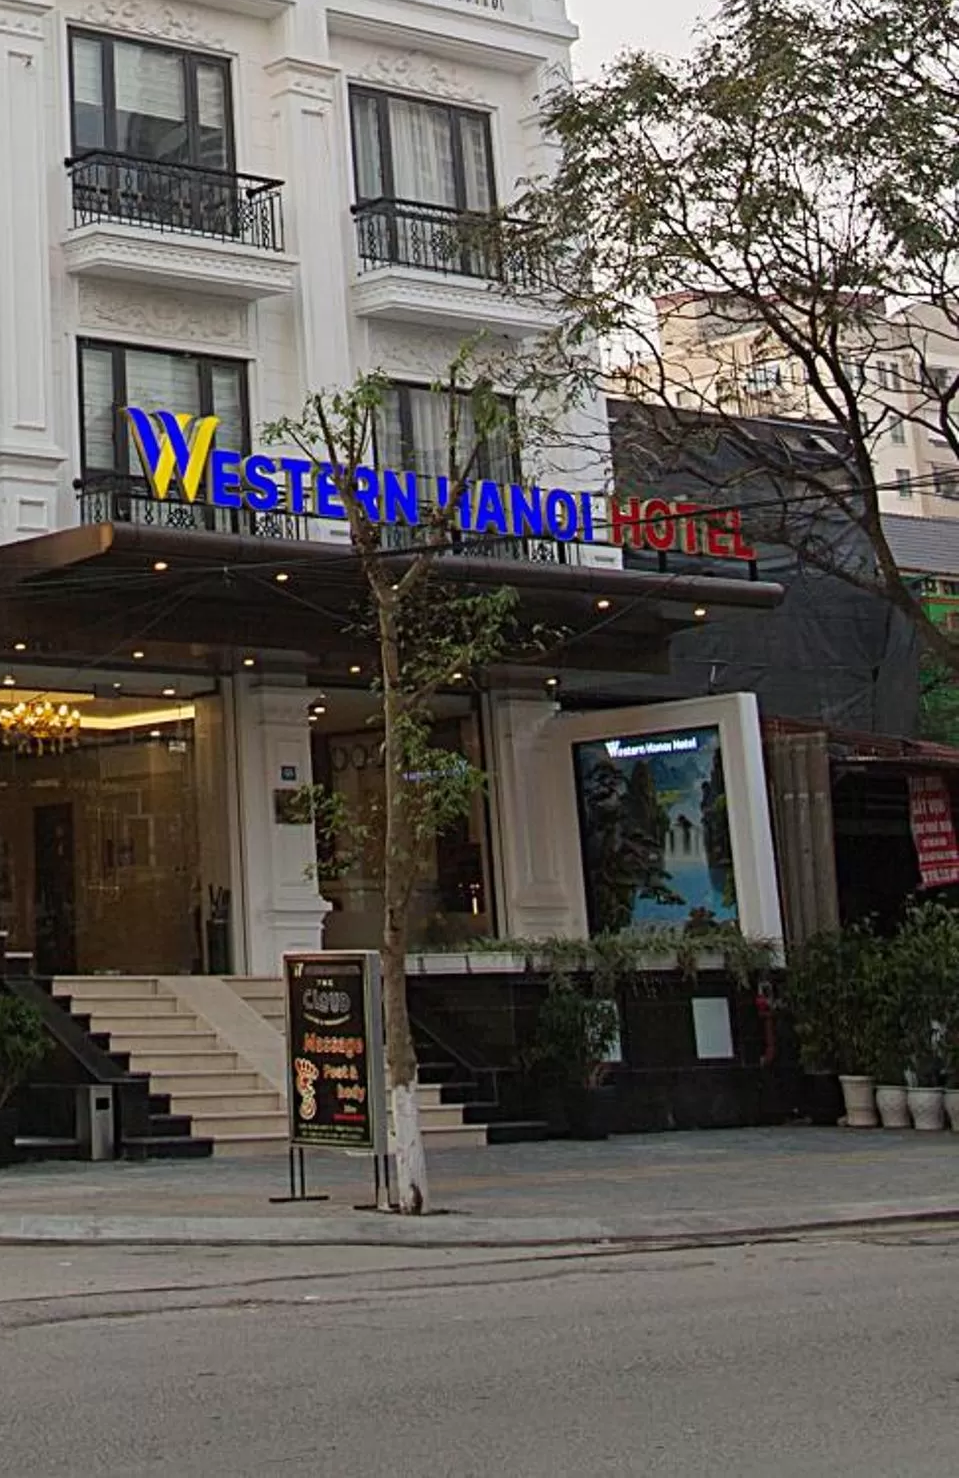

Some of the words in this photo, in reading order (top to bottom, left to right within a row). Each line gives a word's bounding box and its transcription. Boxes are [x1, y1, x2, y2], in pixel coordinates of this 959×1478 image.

[119, 406, 419, 526] WESTERN
[610, 495, 756, 560] HOTEL
[304, 1032, 364, 1058] Massage
